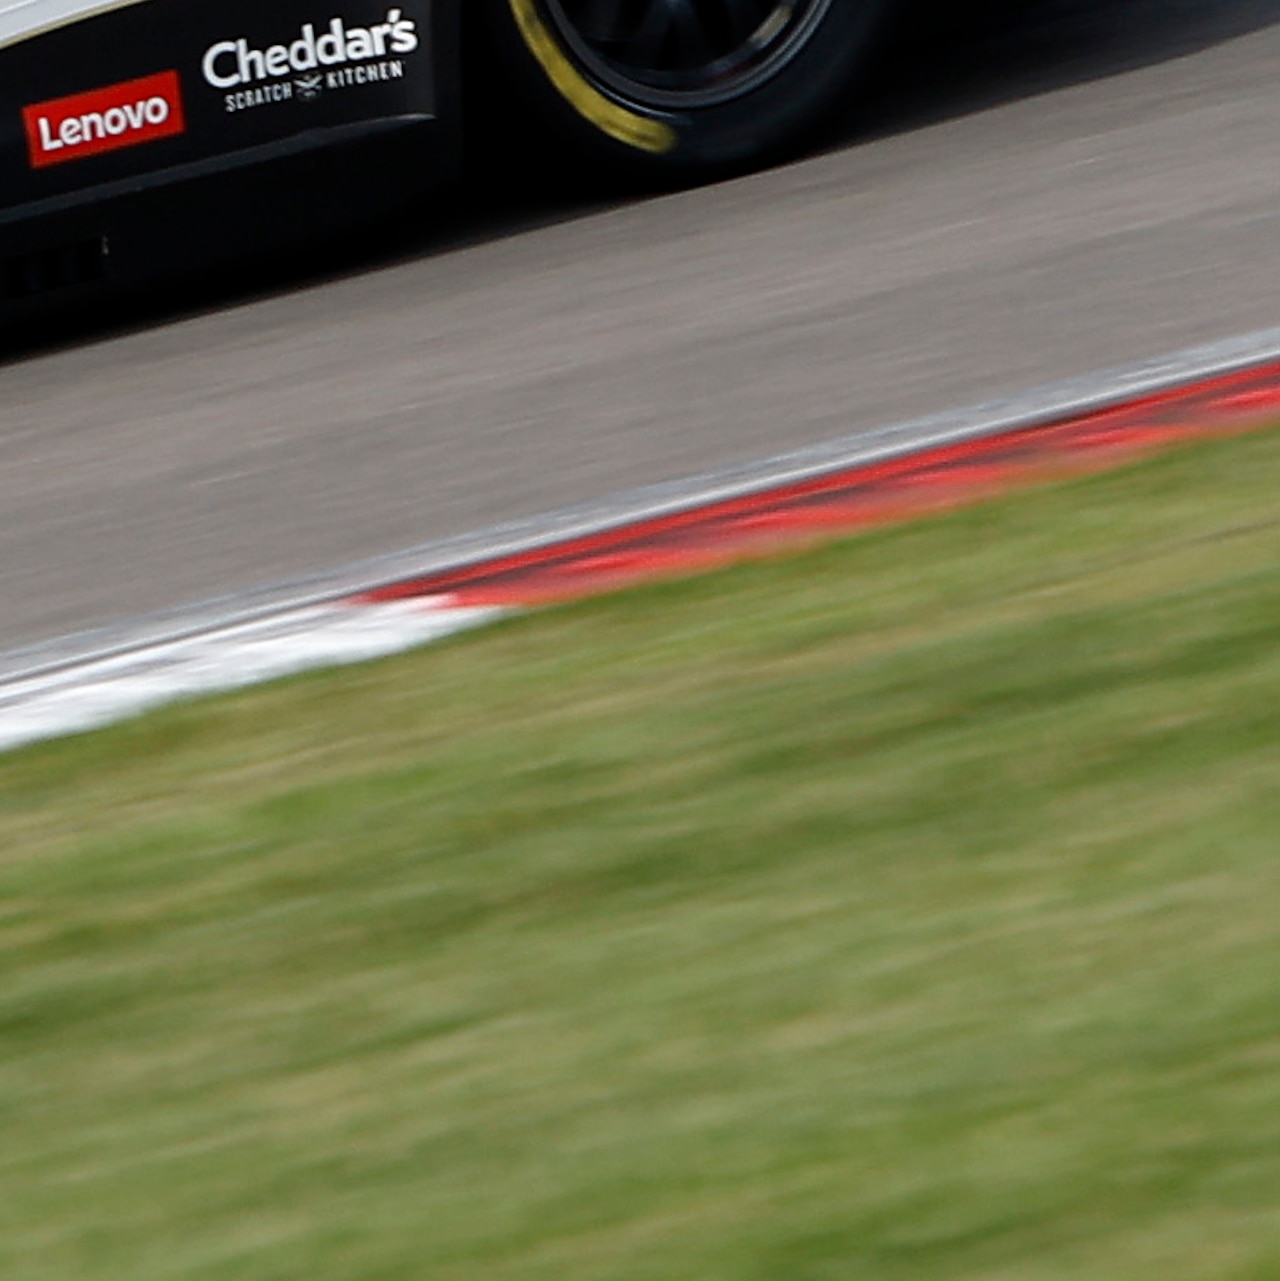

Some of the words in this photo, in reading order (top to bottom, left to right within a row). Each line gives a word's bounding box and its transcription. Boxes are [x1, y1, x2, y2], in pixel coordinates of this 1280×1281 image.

[202, 8, 418, 88] Cheddar's
[224, 81, 293, 112] SCRATCH
[325, 60, 404, 89] KITCHEN
[38, 96, 169, 151] Lenovo
